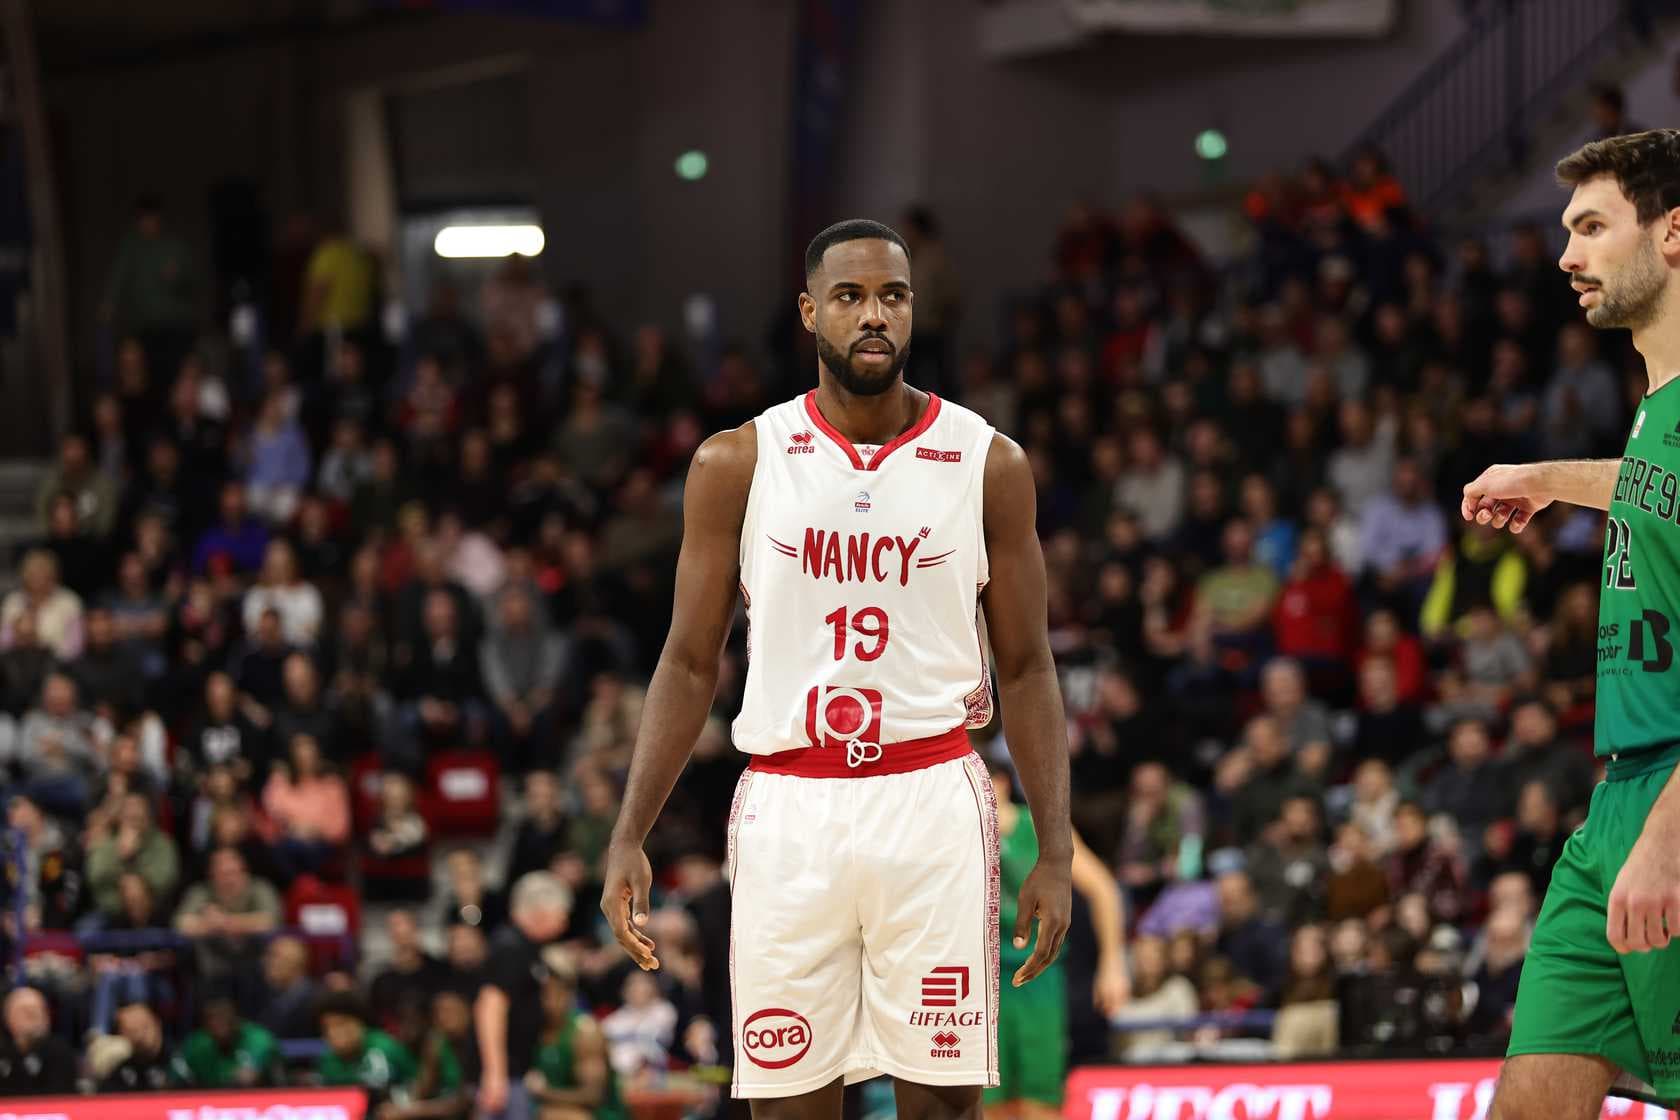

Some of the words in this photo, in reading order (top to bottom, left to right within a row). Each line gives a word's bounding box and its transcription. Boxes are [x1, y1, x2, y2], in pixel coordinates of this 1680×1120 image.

[803, 527, 920, 587] NANCY
[825, 605, 889, 662] 19
[746, 1025, 806, 1050] cora
[909, 1011, 984, 1027] EIFFAGE
